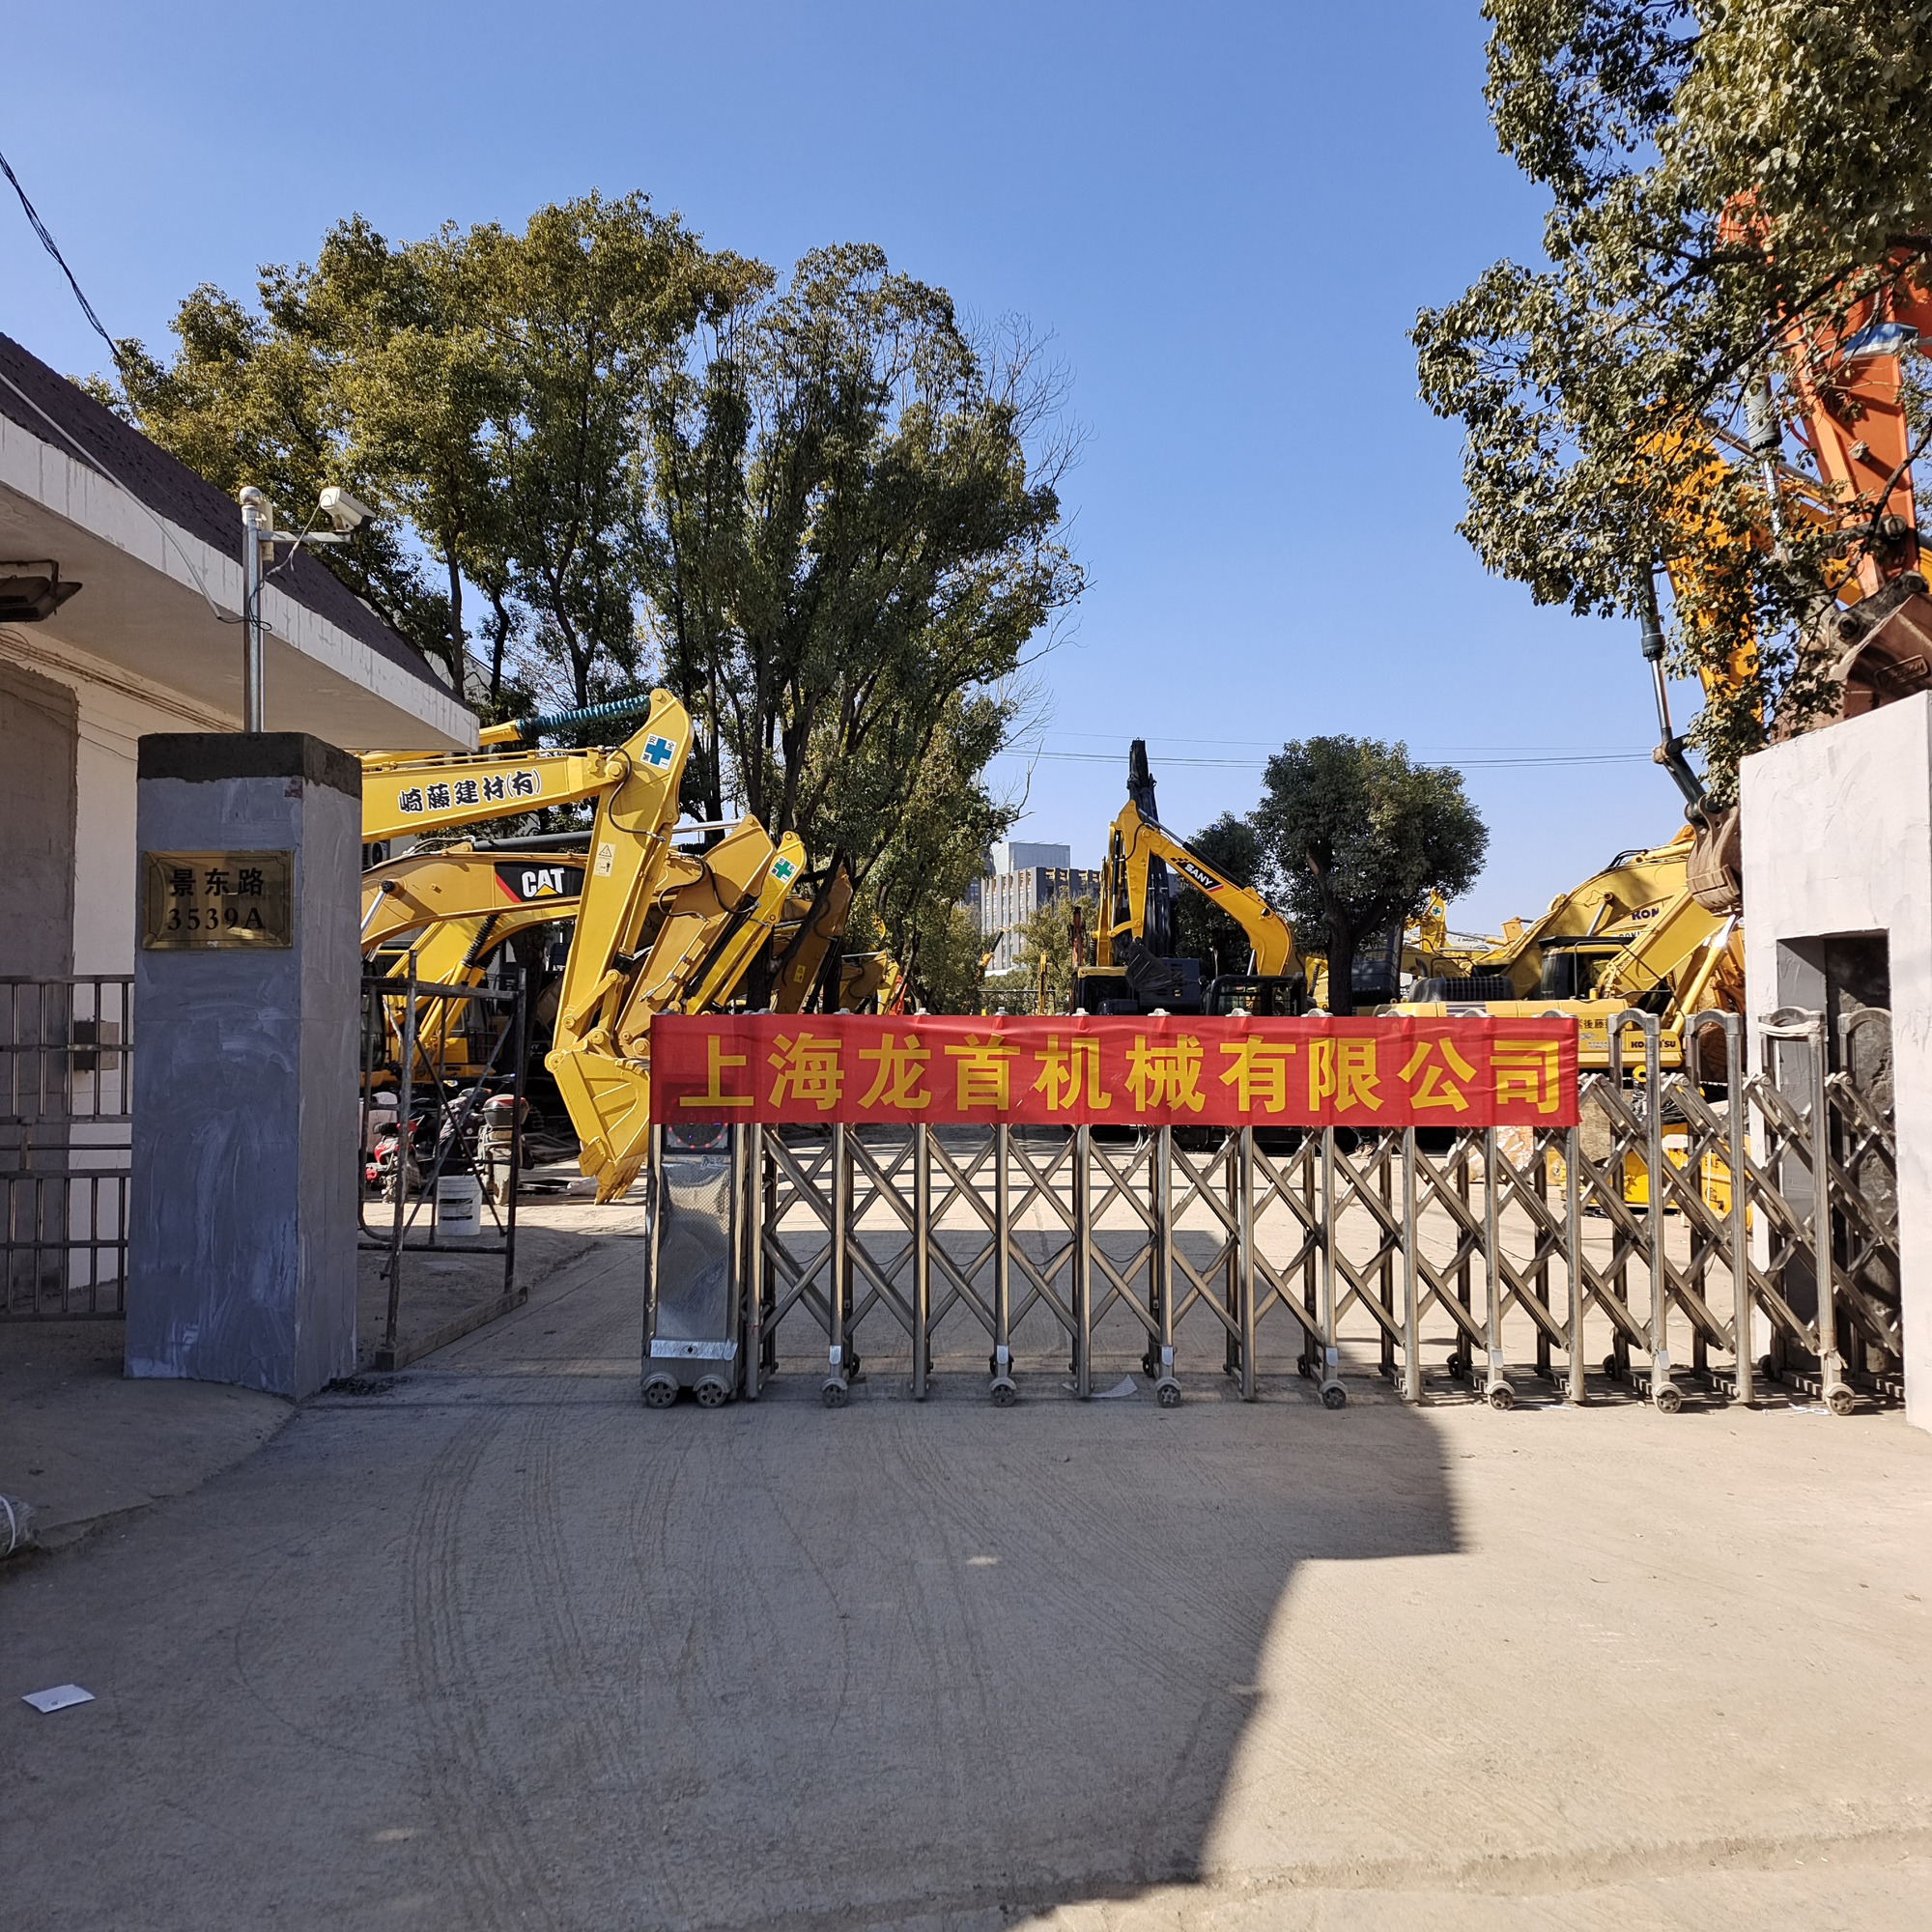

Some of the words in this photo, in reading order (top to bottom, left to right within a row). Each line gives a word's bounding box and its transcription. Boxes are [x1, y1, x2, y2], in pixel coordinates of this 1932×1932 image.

[169, 867, 265, 896] 景东路
[522, 867, 565, 897] CAT
[1184, 863, 1213, 886] SANY
[167, 907, 266, 930] 3539A
[679, 1032, 1560, 1114] 上海龙首机械有限公司
